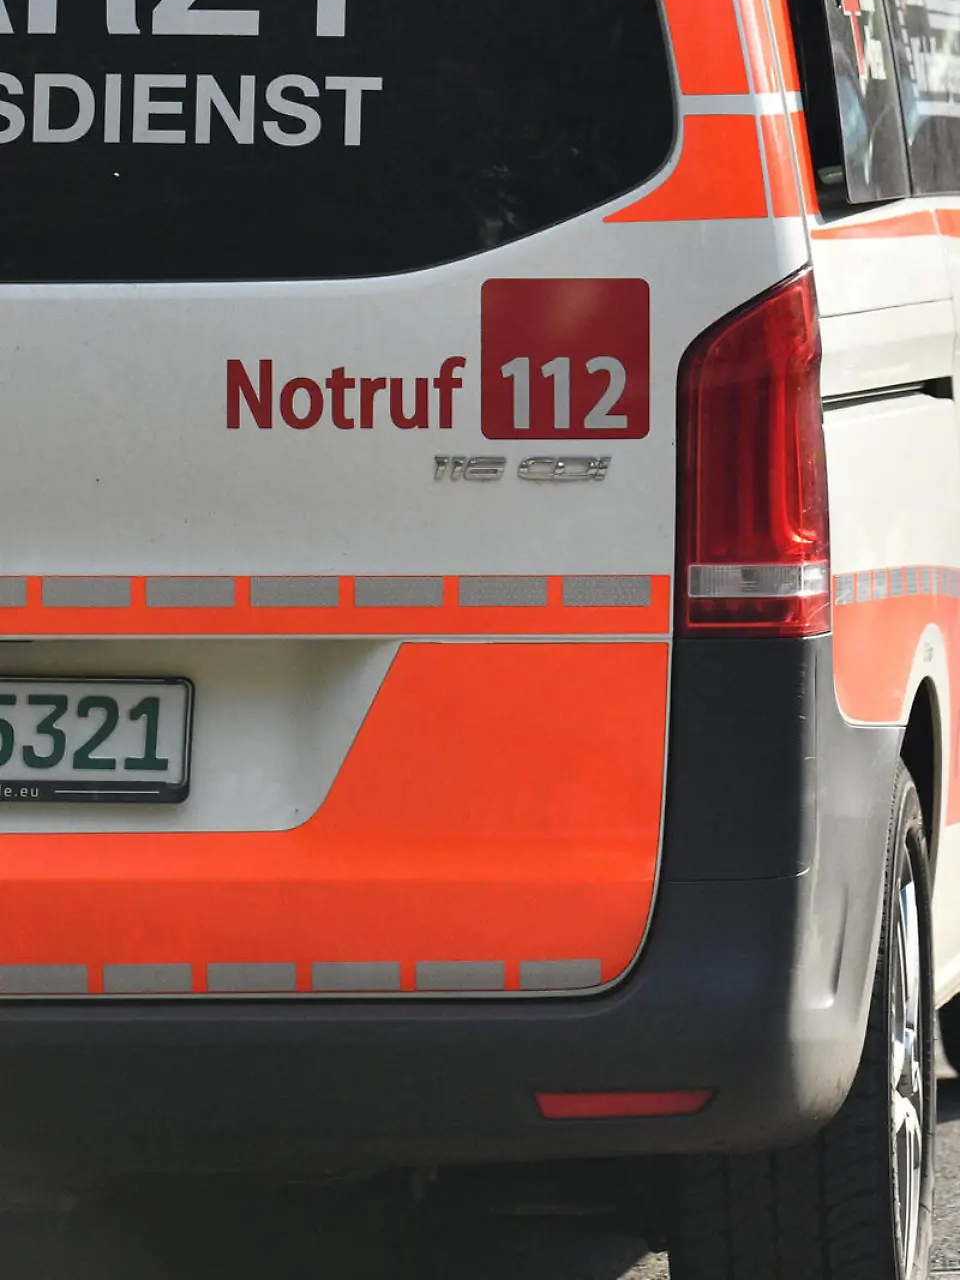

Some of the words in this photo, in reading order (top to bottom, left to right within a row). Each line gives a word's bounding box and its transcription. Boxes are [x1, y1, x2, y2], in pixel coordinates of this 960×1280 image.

[226, 356, 467, 430] Notruf
[501, 355, 628, 430] 112
[516, 455, 611, 482] CDI
